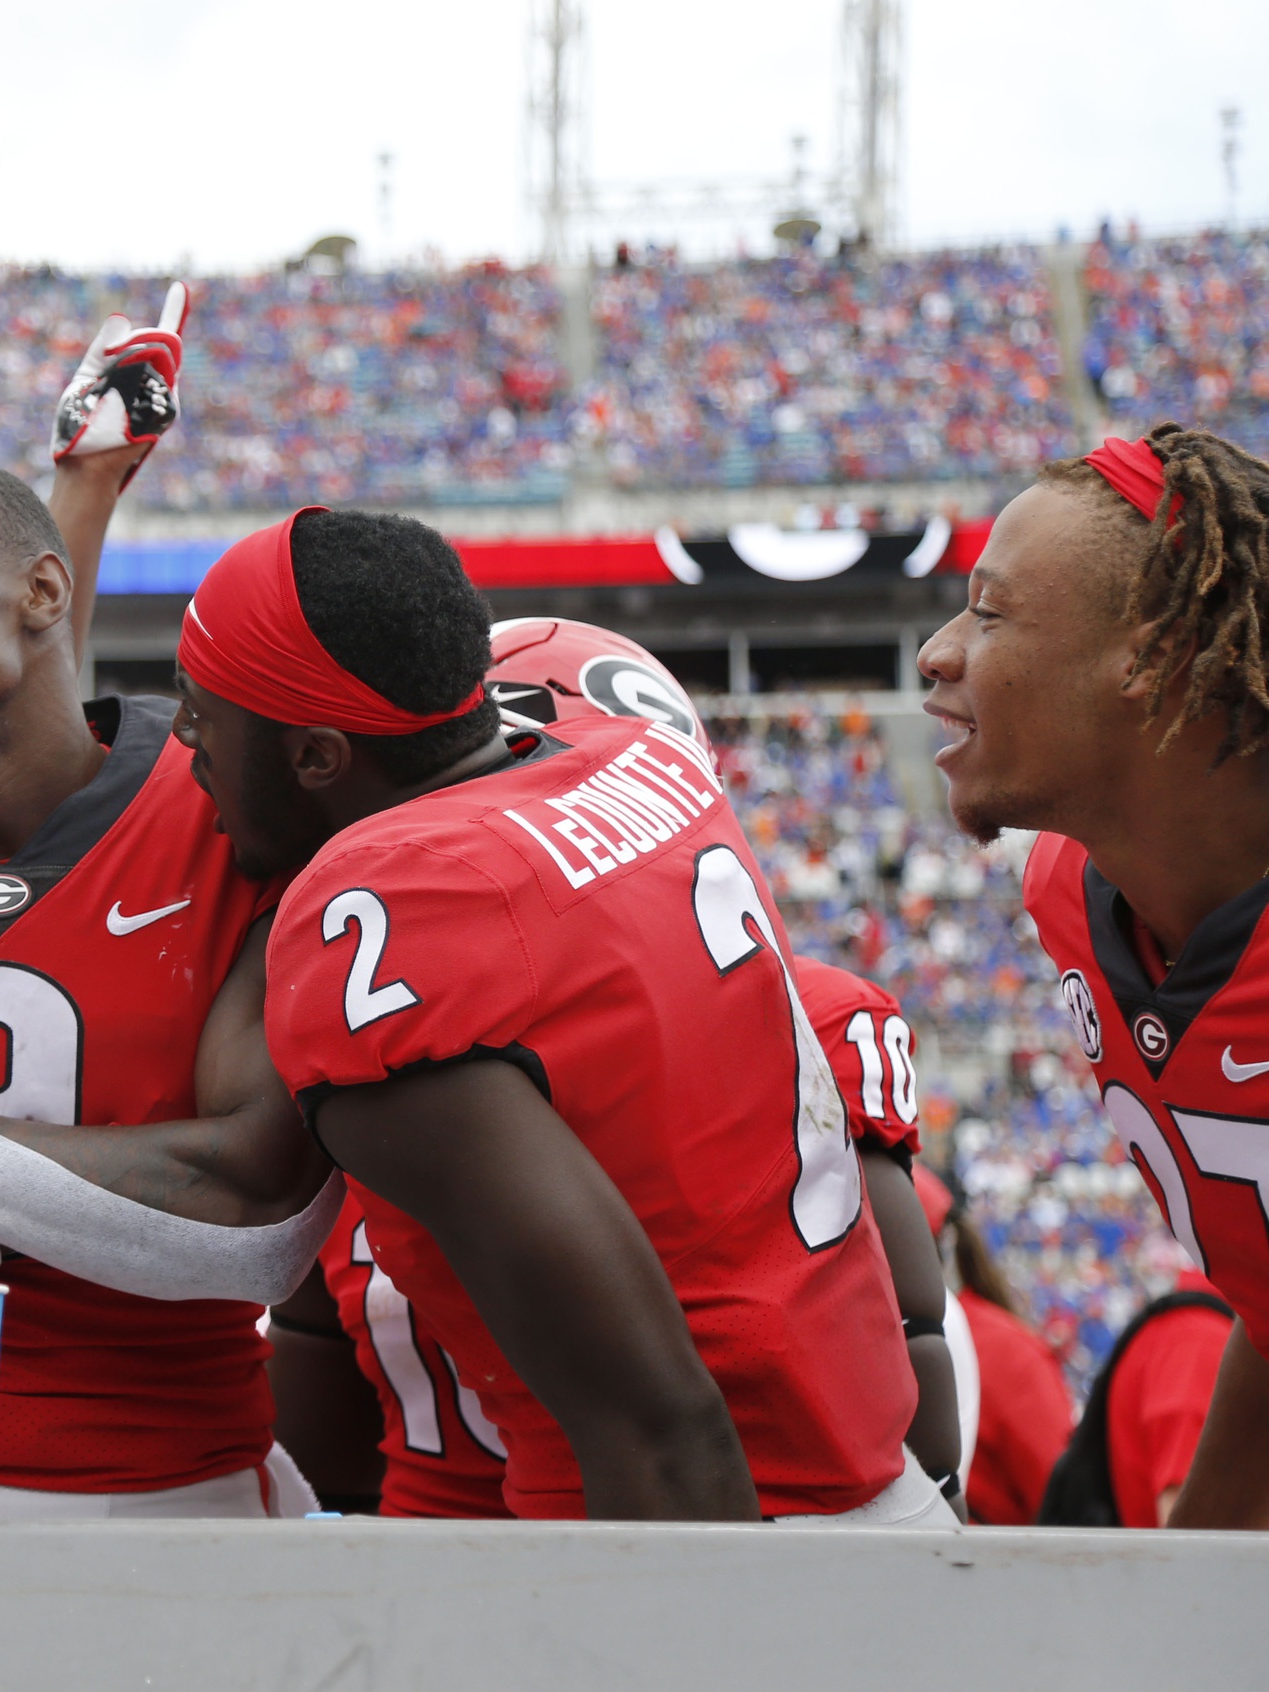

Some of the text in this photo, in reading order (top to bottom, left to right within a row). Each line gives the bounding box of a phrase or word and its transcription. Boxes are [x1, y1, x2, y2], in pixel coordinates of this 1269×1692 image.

[320, 886, 424, 1036] 2
[692, 843, 862, 1254] 2
[846, 1009, 919, 1125] 10
[1135, 1013, 1168, 1059] G
